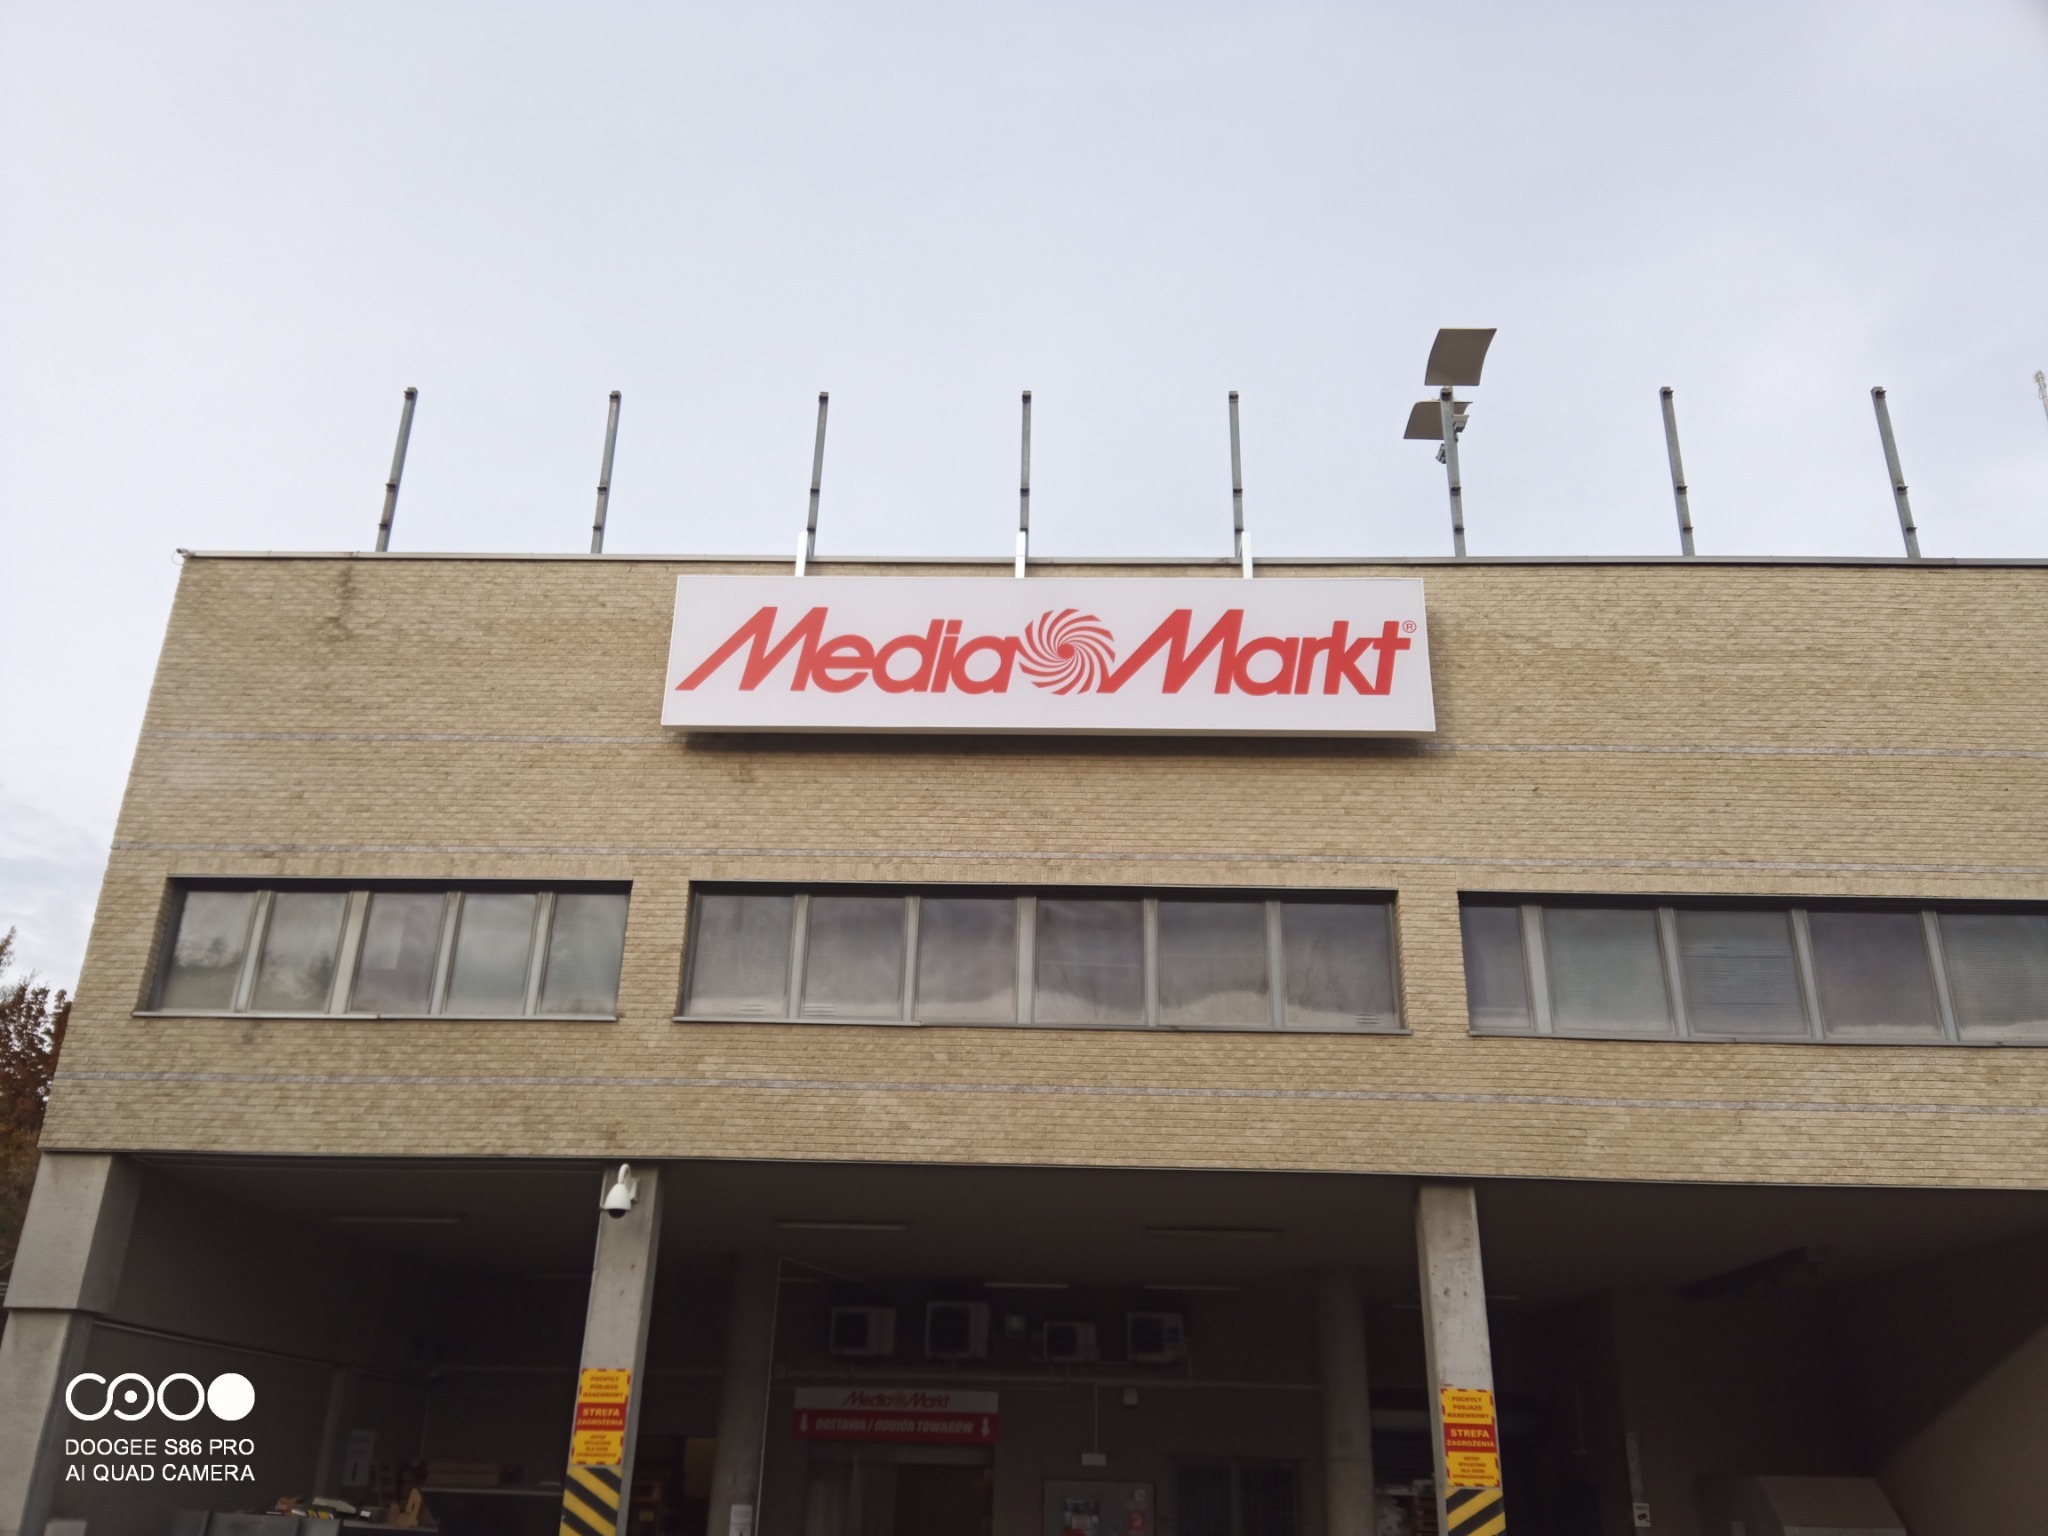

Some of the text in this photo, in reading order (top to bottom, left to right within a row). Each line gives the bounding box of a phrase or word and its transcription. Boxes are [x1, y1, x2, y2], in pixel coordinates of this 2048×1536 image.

[675, 606, 1021, 694] Media
[1099, 608, 1411, 696] Markt
[843, 1390, 950, 1409] Media Markt
[582, 1408, 620, 1417] STREFA
[816, 1417, 867, 1432] DOSTAWA
[1450, 1428, 1490, 1439] STREFA
